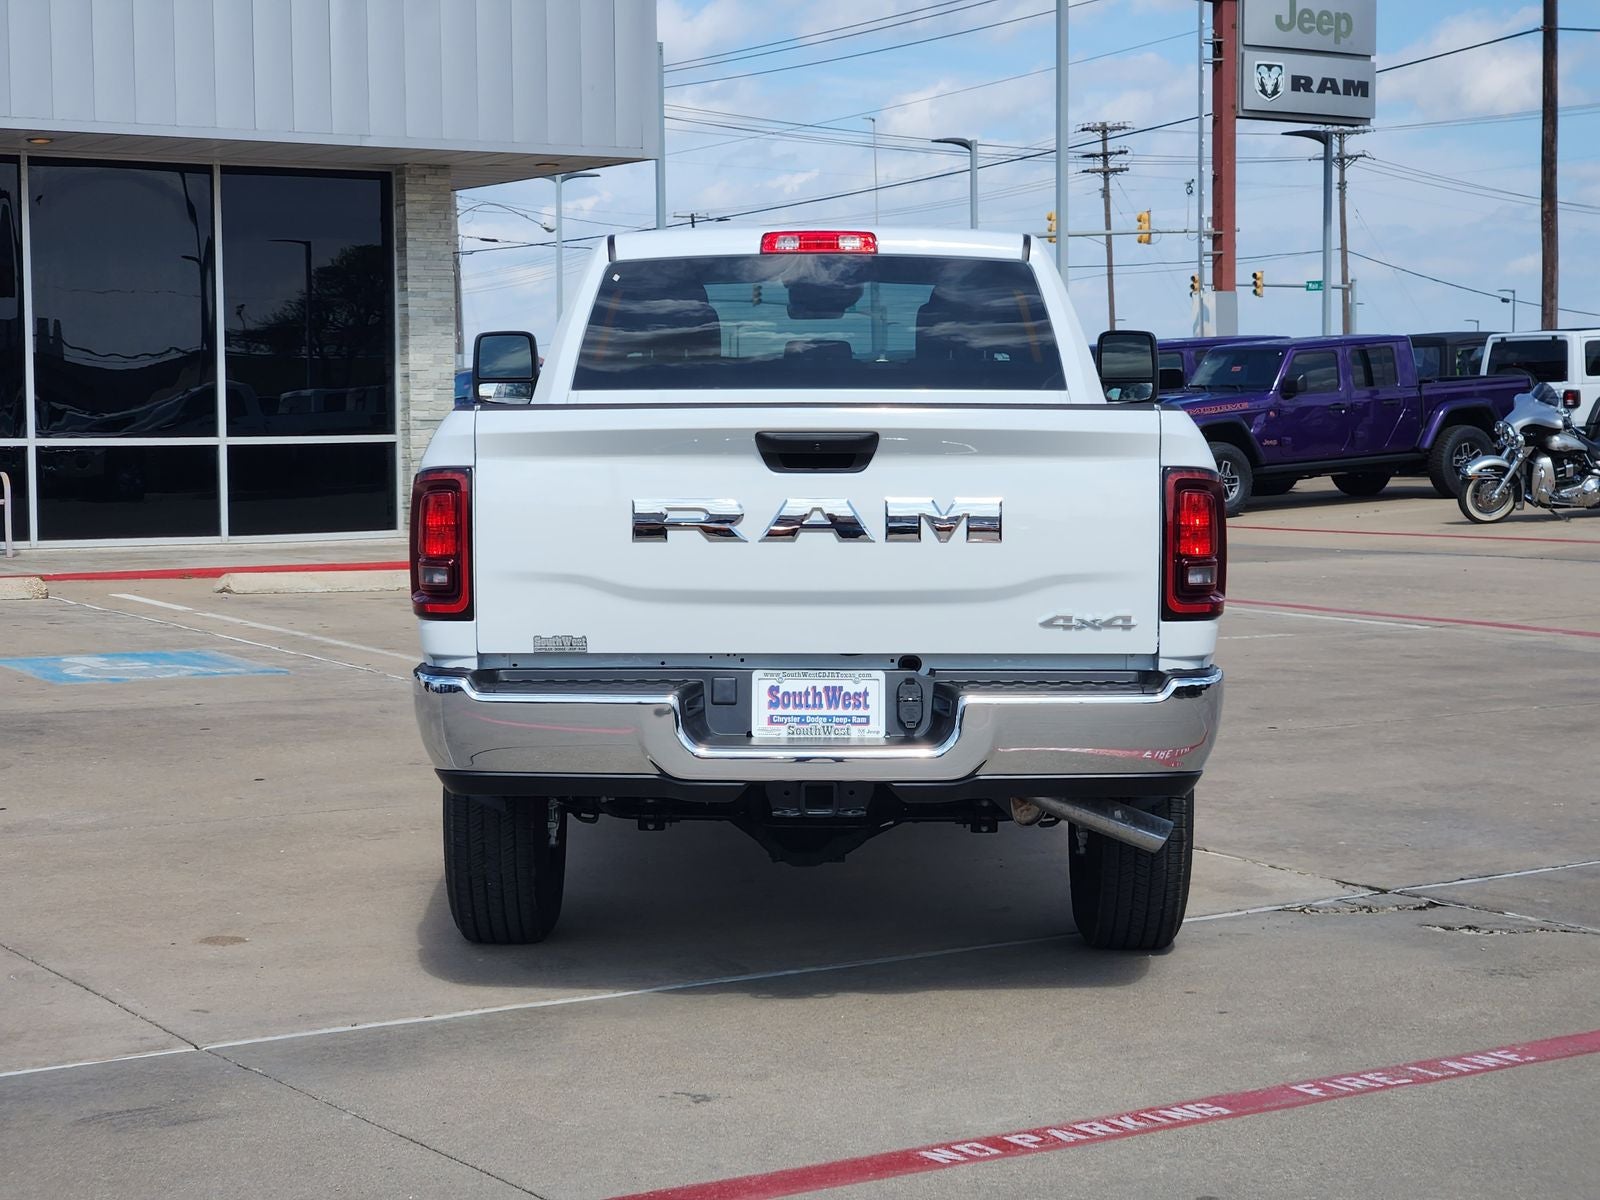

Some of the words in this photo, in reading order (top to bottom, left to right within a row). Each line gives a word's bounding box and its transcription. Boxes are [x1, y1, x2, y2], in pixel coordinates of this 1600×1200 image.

[1275, 0, 1353, 45] Jeep
[1291, 74, 1369, 98] RAM
[632, 497, 1003, 543] RAM
[1038, 615, 1137, 631] 4x4
[534, 635, 587, 647] SouthWest
[767, 684, 870, 711] SouthWest
[772, 715, 801, 724] Chrysler
[806, 715, 827, 724] Dodge
[832, 715, 848, 724] Jeep
[852, 715, 867, 723] Ram
[787, 725, 851, 736] SouthWest
[919, 1142, 1002, 1163] NO
[1003, 1102, 1232, 1149] PARKING
[1290, 1072, 1413, 1096] FIRE
[1407, 1049, 1536, 1077] LANE
